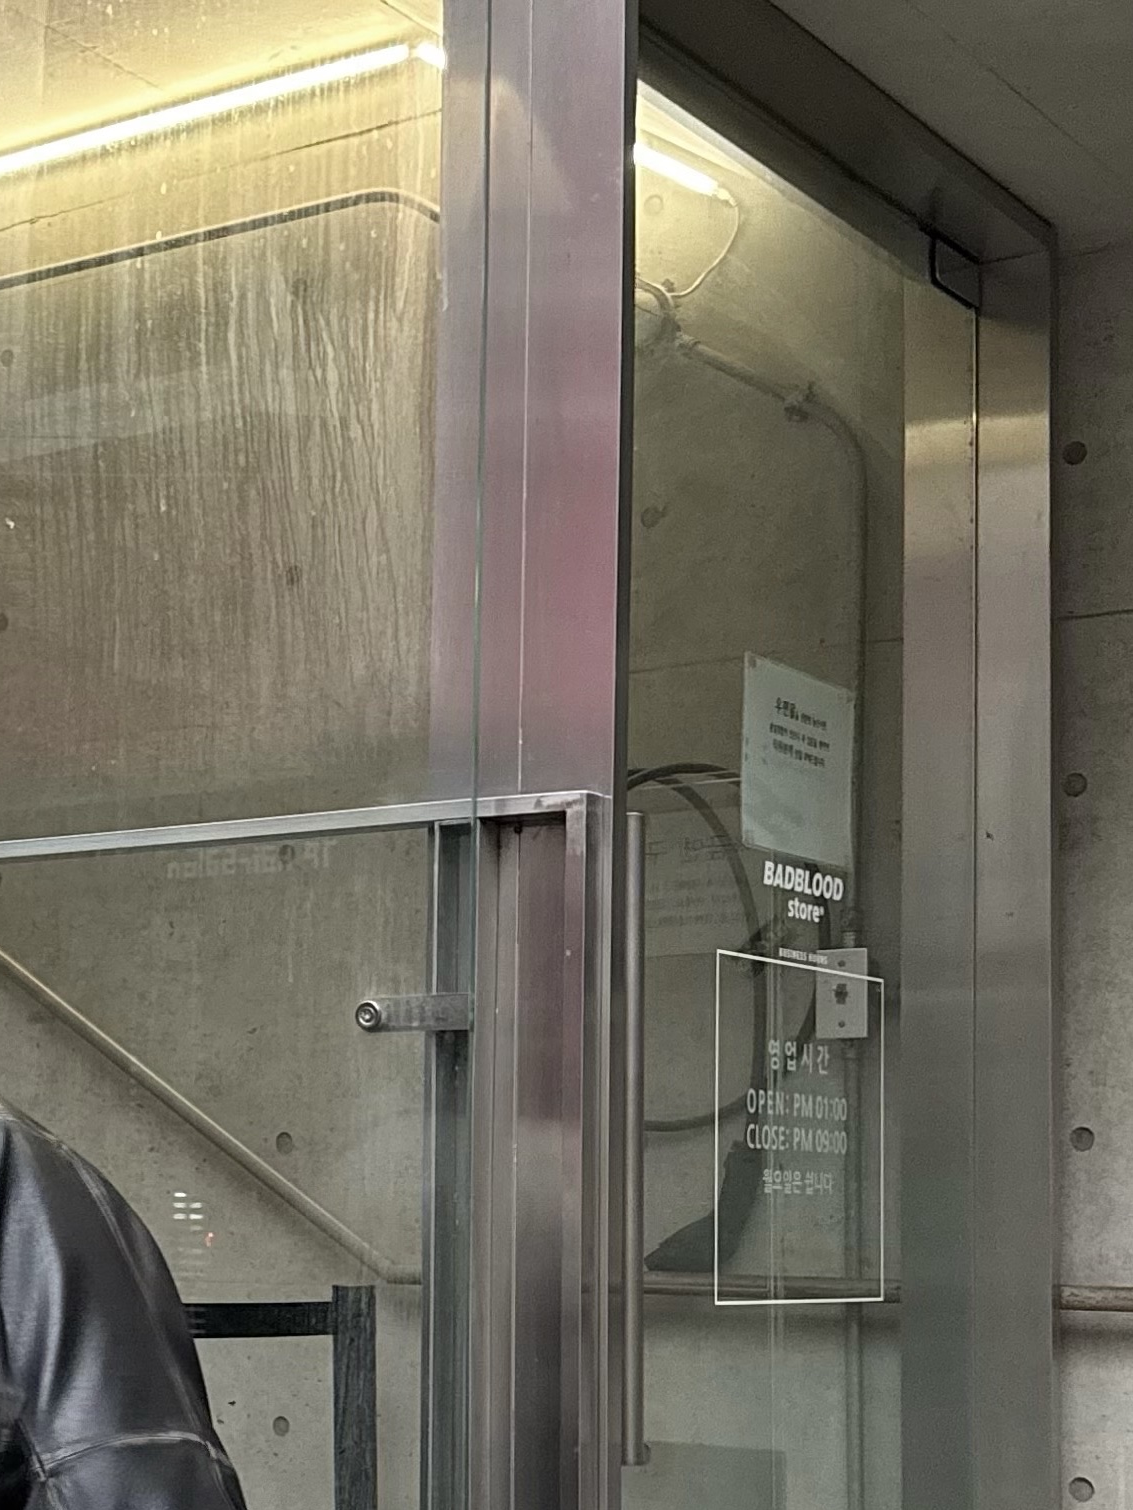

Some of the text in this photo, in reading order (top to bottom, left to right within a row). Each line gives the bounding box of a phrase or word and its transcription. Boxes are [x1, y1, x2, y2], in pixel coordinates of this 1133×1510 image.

[763, 860, 844, 901] BADBLOOD
[747, 1087, 848, 1121] OPEN: PM 01:00
[747, 1123, 848, 1155] CLOSE: PM 09:00
